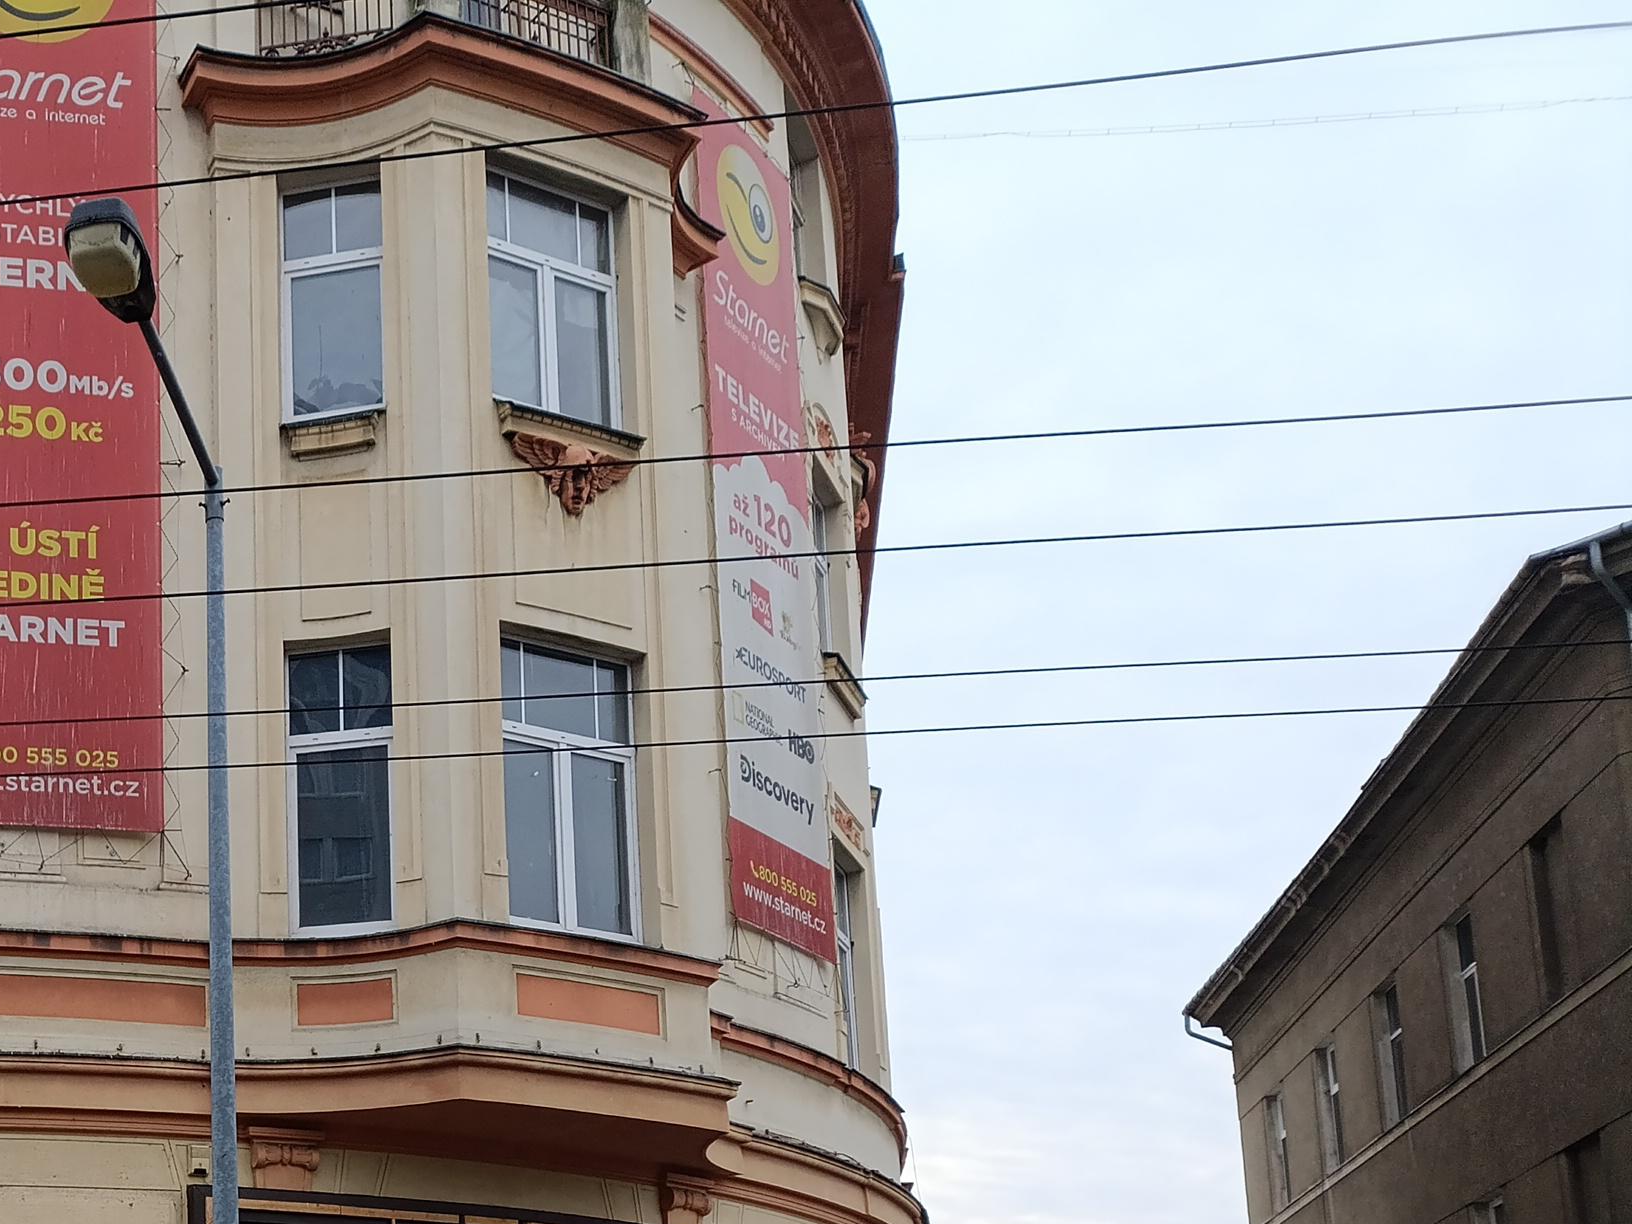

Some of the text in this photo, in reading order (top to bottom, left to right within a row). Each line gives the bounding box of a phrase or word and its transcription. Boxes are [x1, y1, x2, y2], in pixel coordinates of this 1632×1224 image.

[25, 108, 36, 120] a
[44, 107, 106, 126] internet
[712, 269, 789, 364] Starnet
[714, 363, 801, 456] TELEVIZE
[70, 420, 104, 443] Kč
[9, 520, 101, 560] ÚSTÍ
[733, 493, 793, 549] až 120
[738, 647, 806, 704] EUROSPORT
[745, 700, 775, 729] NATIONAL
[26, 747, 68, 766] 555
[75, 749, 119, 768] 025
[788, 729, 815, 765] HBO
[739, 753, 815, 825] Discovery
[743, 881, 827, 935] www.starnet.cz
[758, 865, 817, 908] 800 555 025
